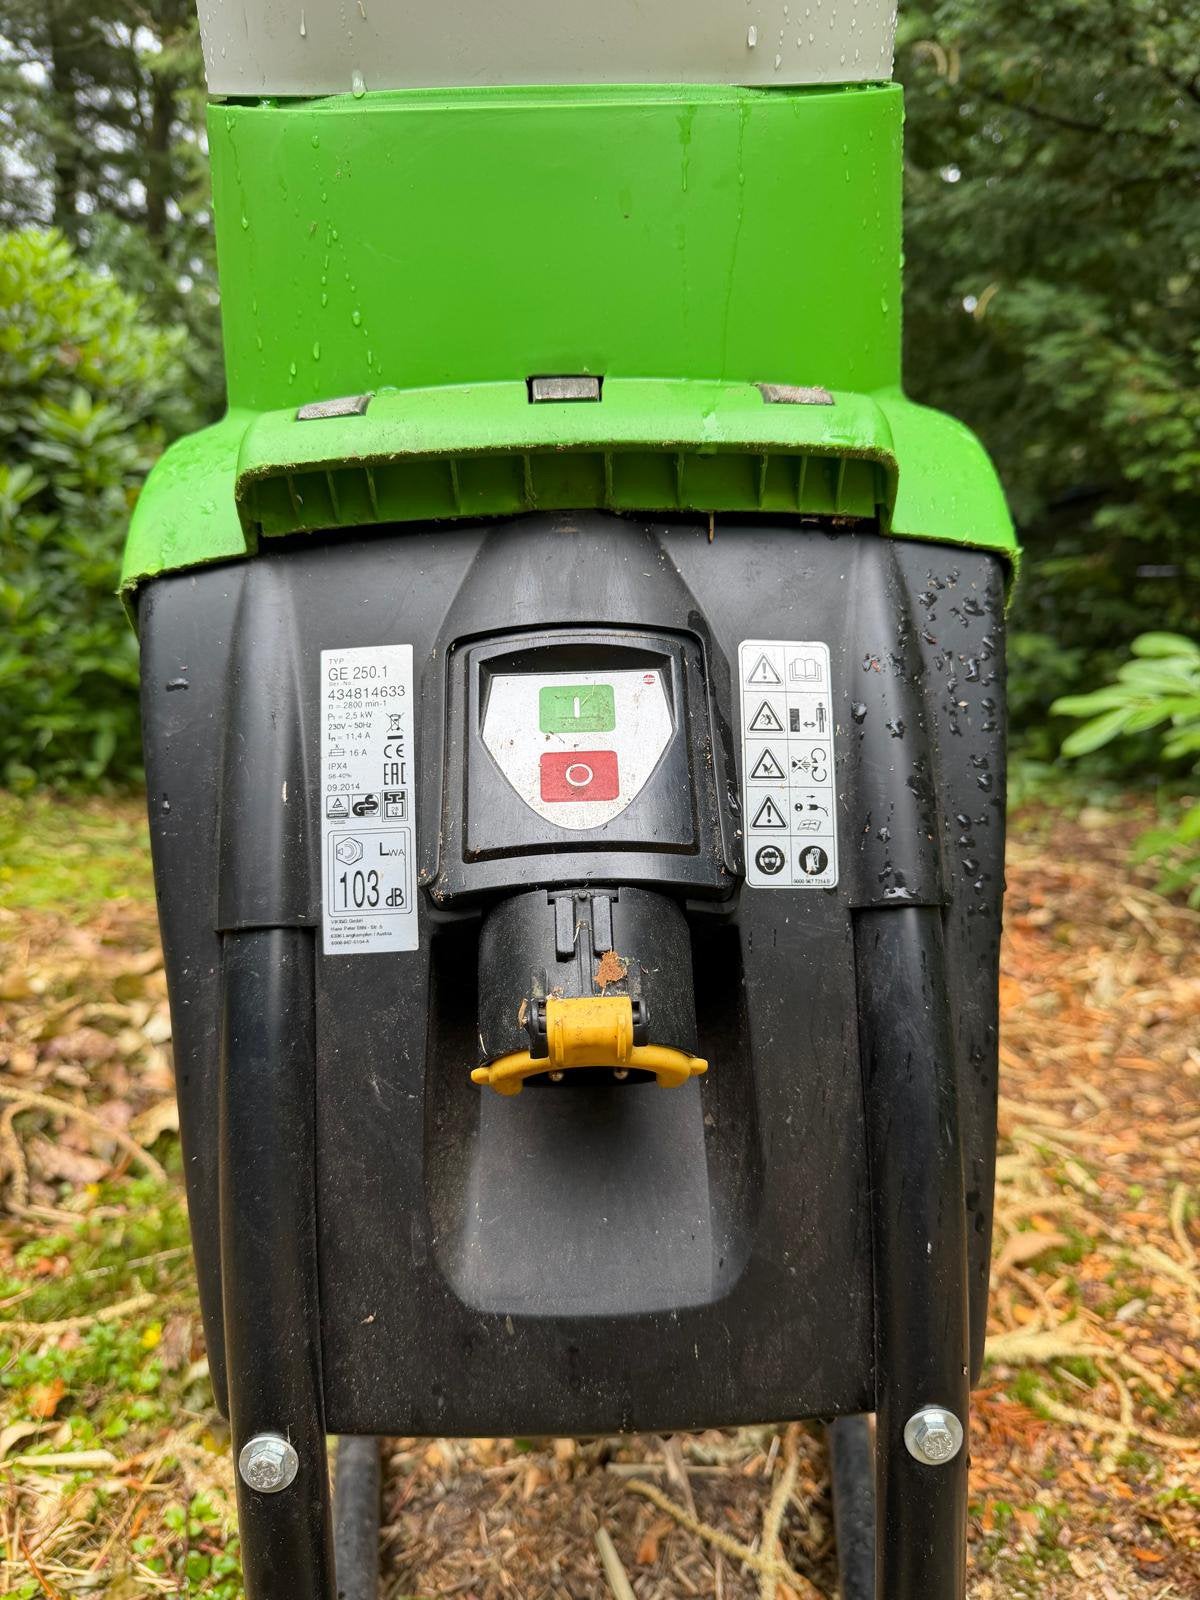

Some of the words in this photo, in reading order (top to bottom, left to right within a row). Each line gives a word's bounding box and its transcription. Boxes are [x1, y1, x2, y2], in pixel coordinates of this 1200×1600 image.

[328, 667, 349, 681] GE
[353, 665, 388, 680] 250.1
[328, 685, 406, 700] 434814633
[344, 701, 362, 709] 2800
[362, 748, 368, 756] A
[384, 744, 404, 759] CE
[384, 762, 406, 786] EAC
[327, 784, 360, 792] 09.2014
[340, 870, 380, 908] 103
[386, 888, 404, 907] dB
